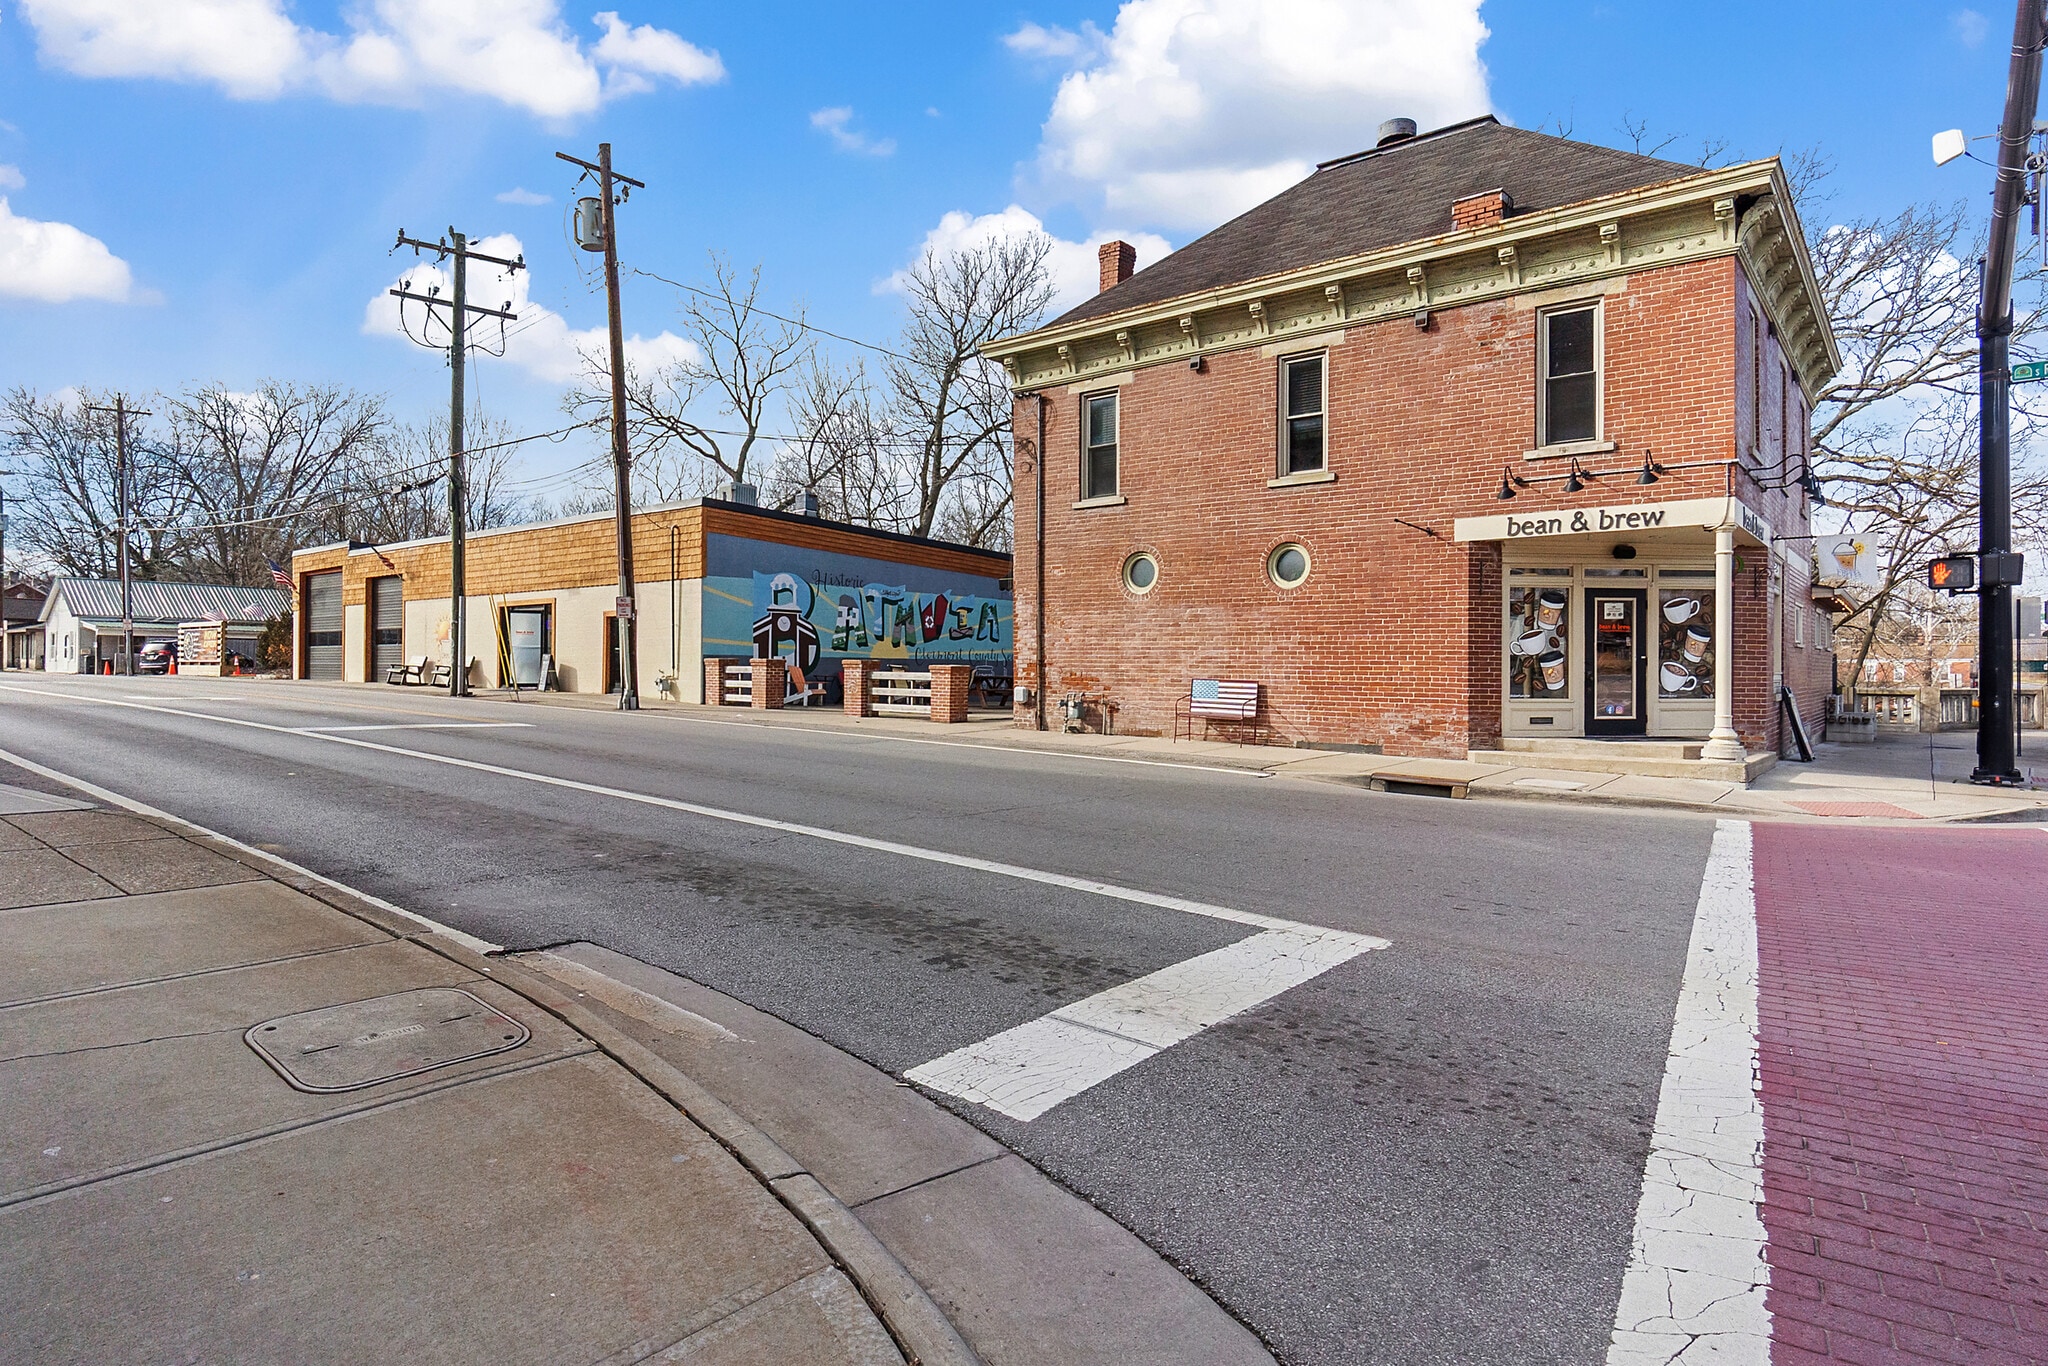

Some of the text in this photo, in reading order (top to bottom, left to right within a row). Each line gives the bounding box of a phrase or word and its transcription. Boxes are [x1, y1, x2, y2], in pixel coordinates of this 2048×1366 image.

[2034, 368, 2041, 377] S
[1507, 509, 1665, 537] bean & brew
[811, 568, 864, 598] Historic
[753, 570, 1000, 677] BATAVIA
[914, 646, 1013, 668] Clermont County Se
